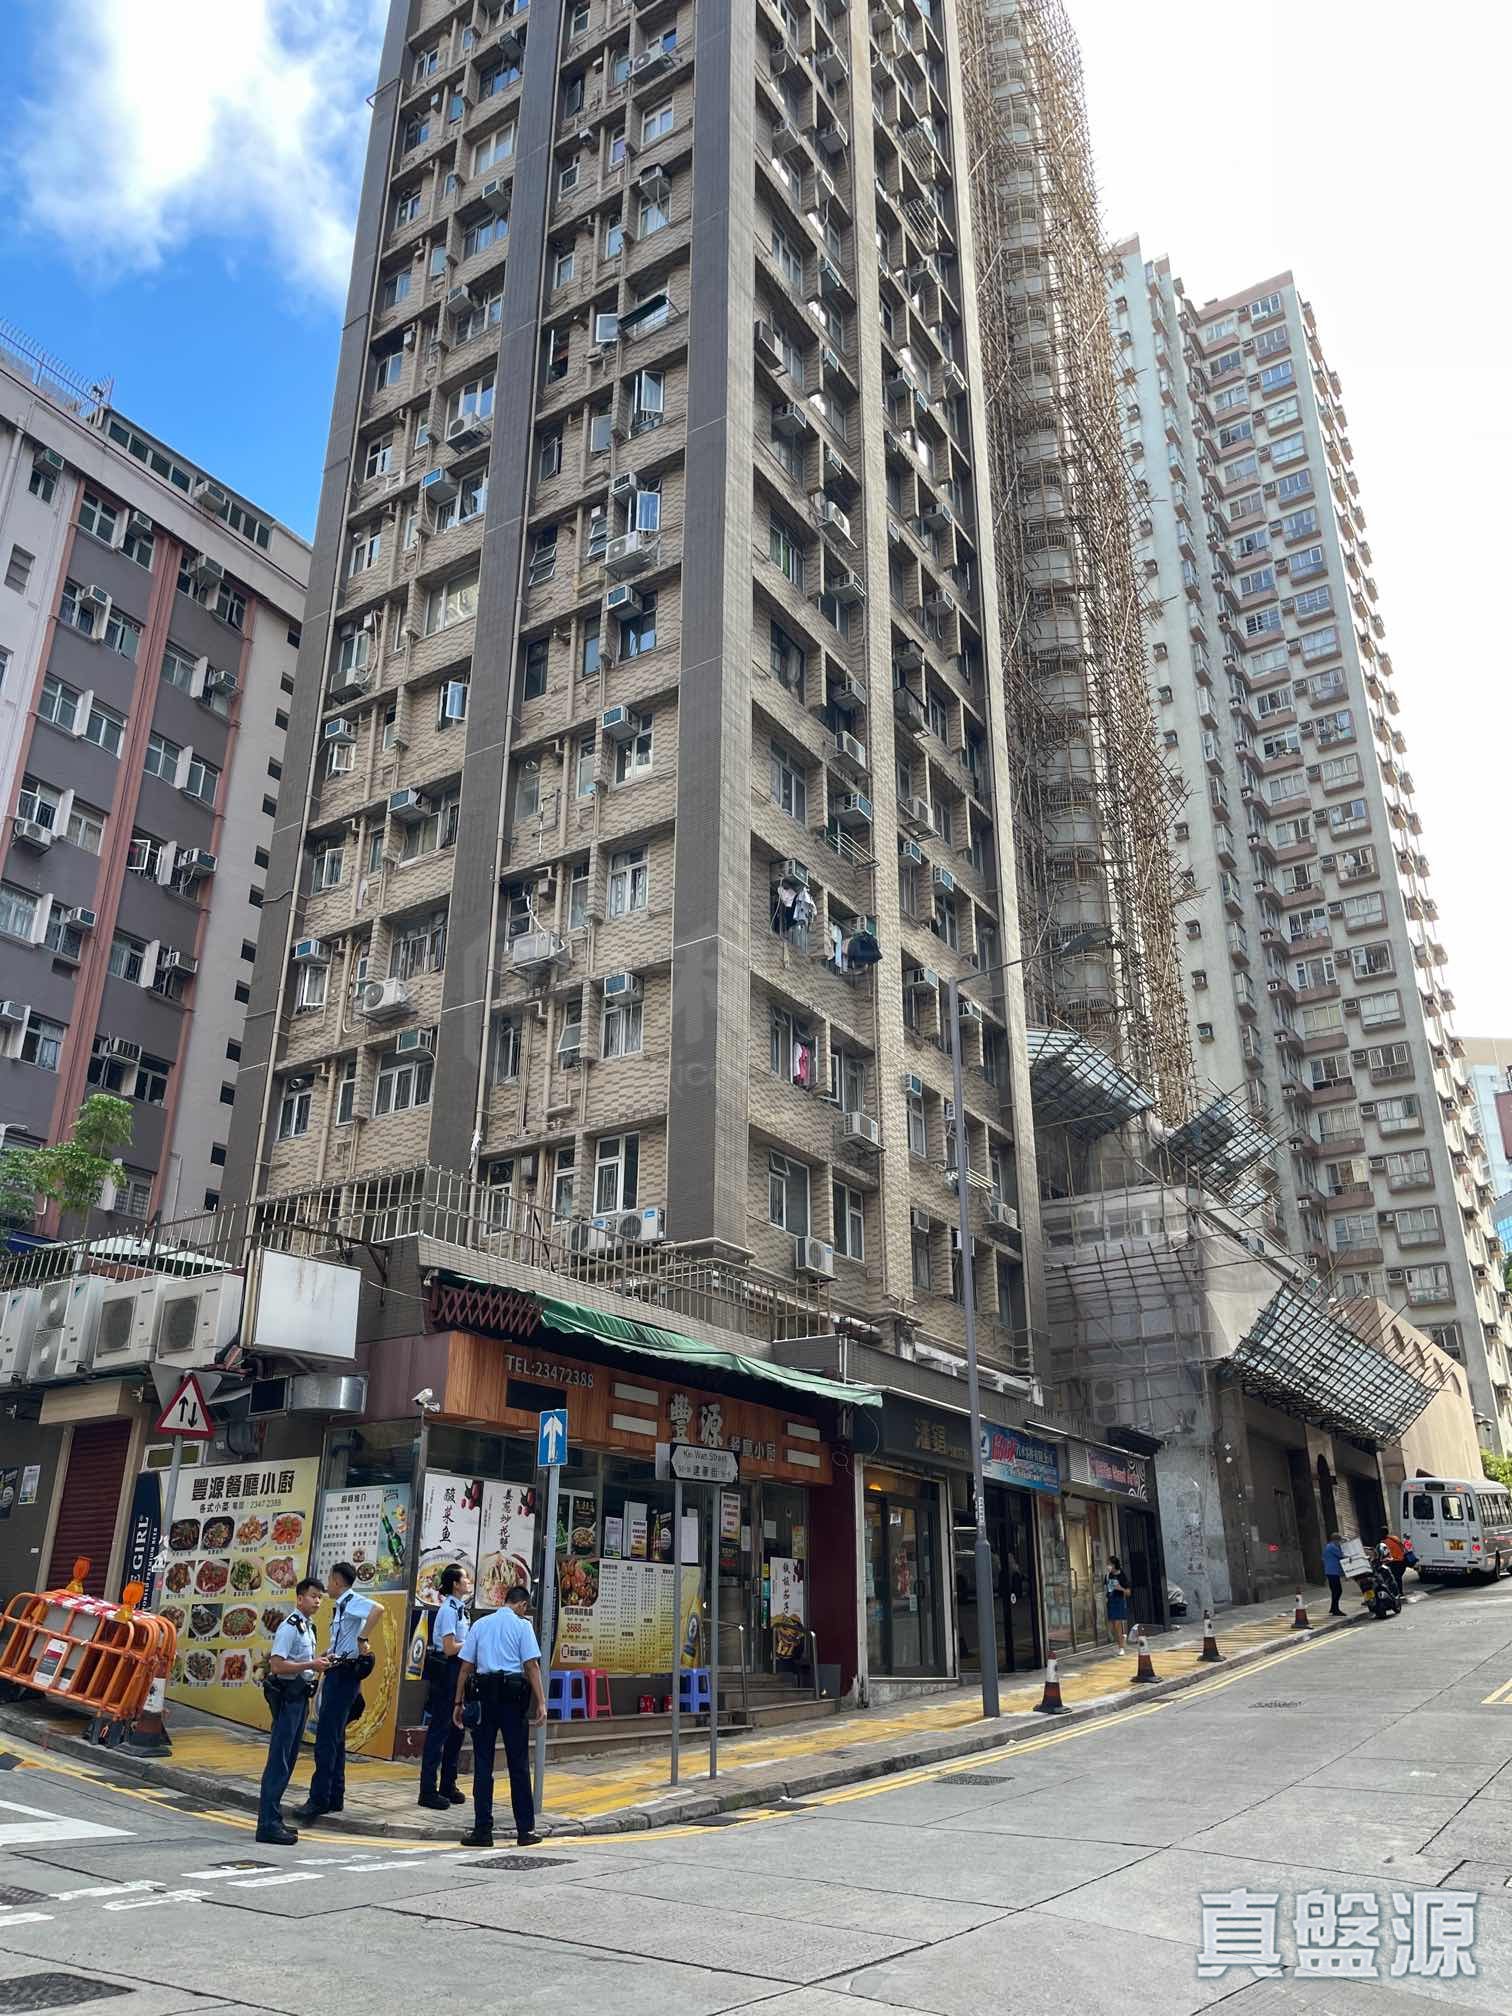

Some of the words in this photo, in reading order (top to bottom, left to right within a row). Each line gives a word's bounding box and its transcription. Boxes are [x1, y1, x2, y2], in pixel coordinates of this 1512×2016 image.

[191, 1470, 296, 1501] 豐源餐廳小廚
[132, 1516, 149, 1570] GIRL
